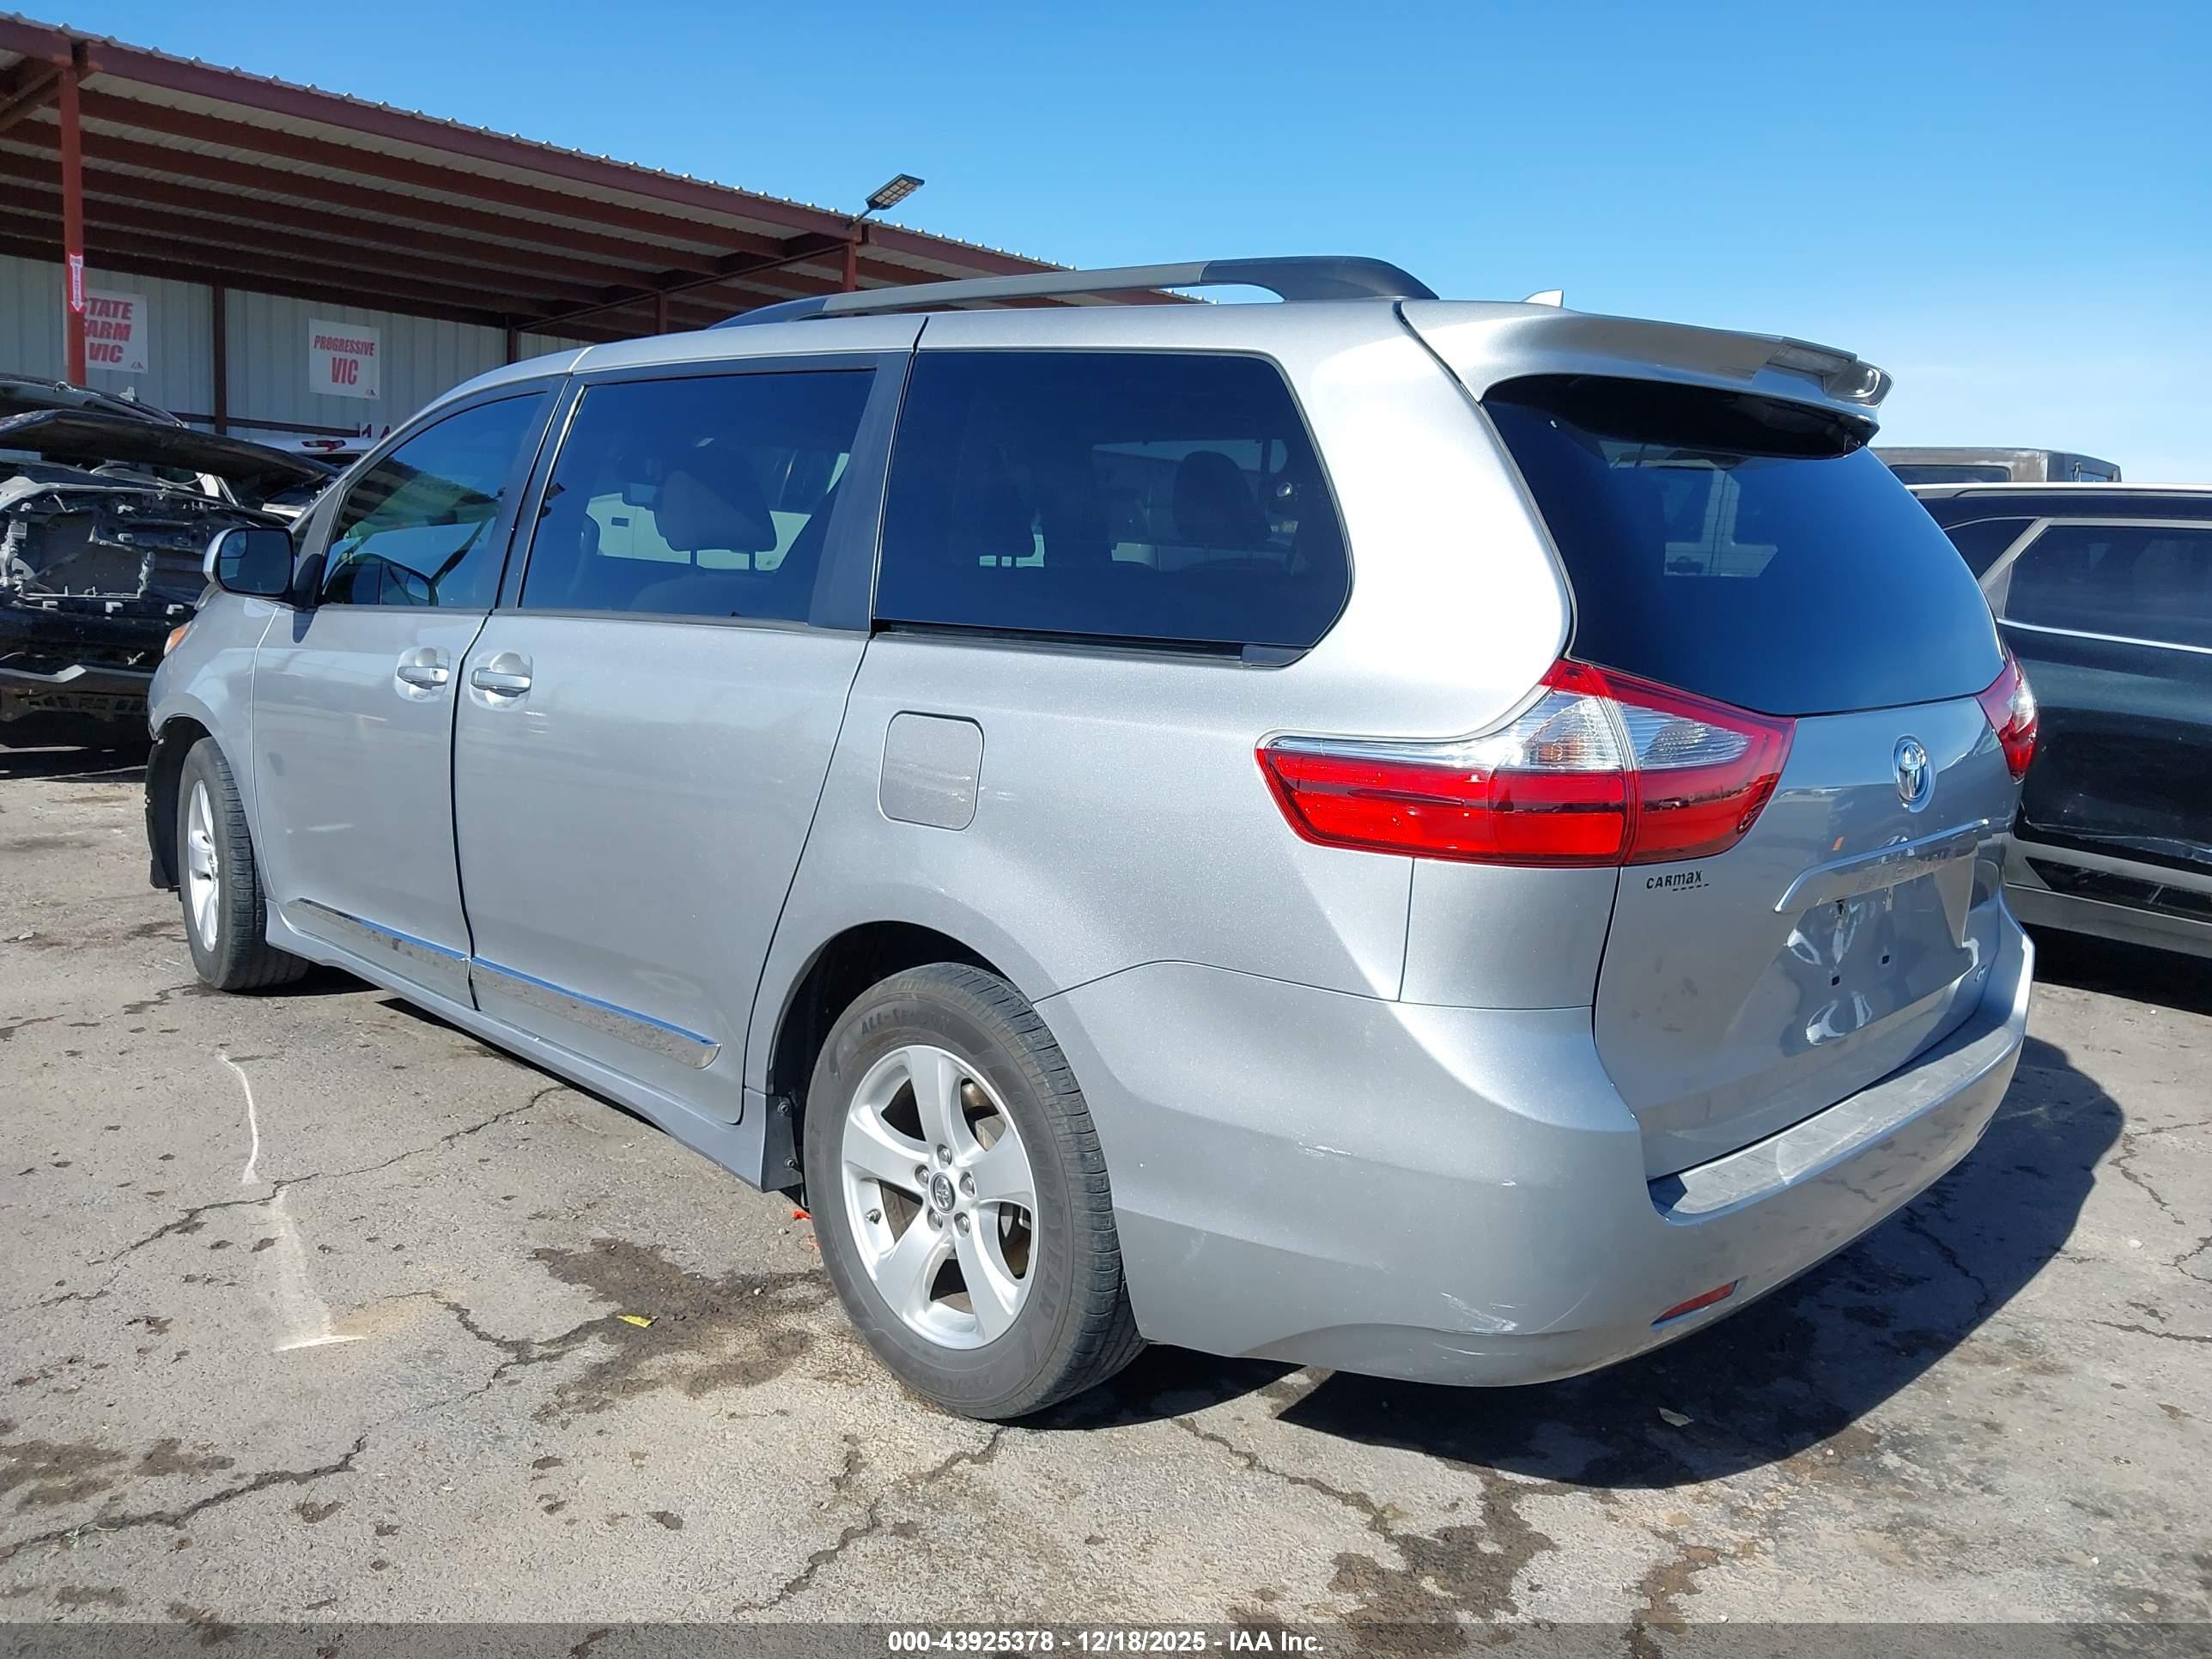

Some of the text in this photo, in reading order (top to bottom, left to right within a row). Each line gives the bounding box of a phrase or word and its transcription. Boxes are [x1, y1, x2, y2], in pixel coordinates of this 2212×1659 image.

[85, 297, 133, 320] TATE
[84, 319, 132, 342] ARM
[88, 342, 124, 363] VIC
[313, 335, 375, 356] PROGRESSIVE
[331, 356, 359, 386] VIC
